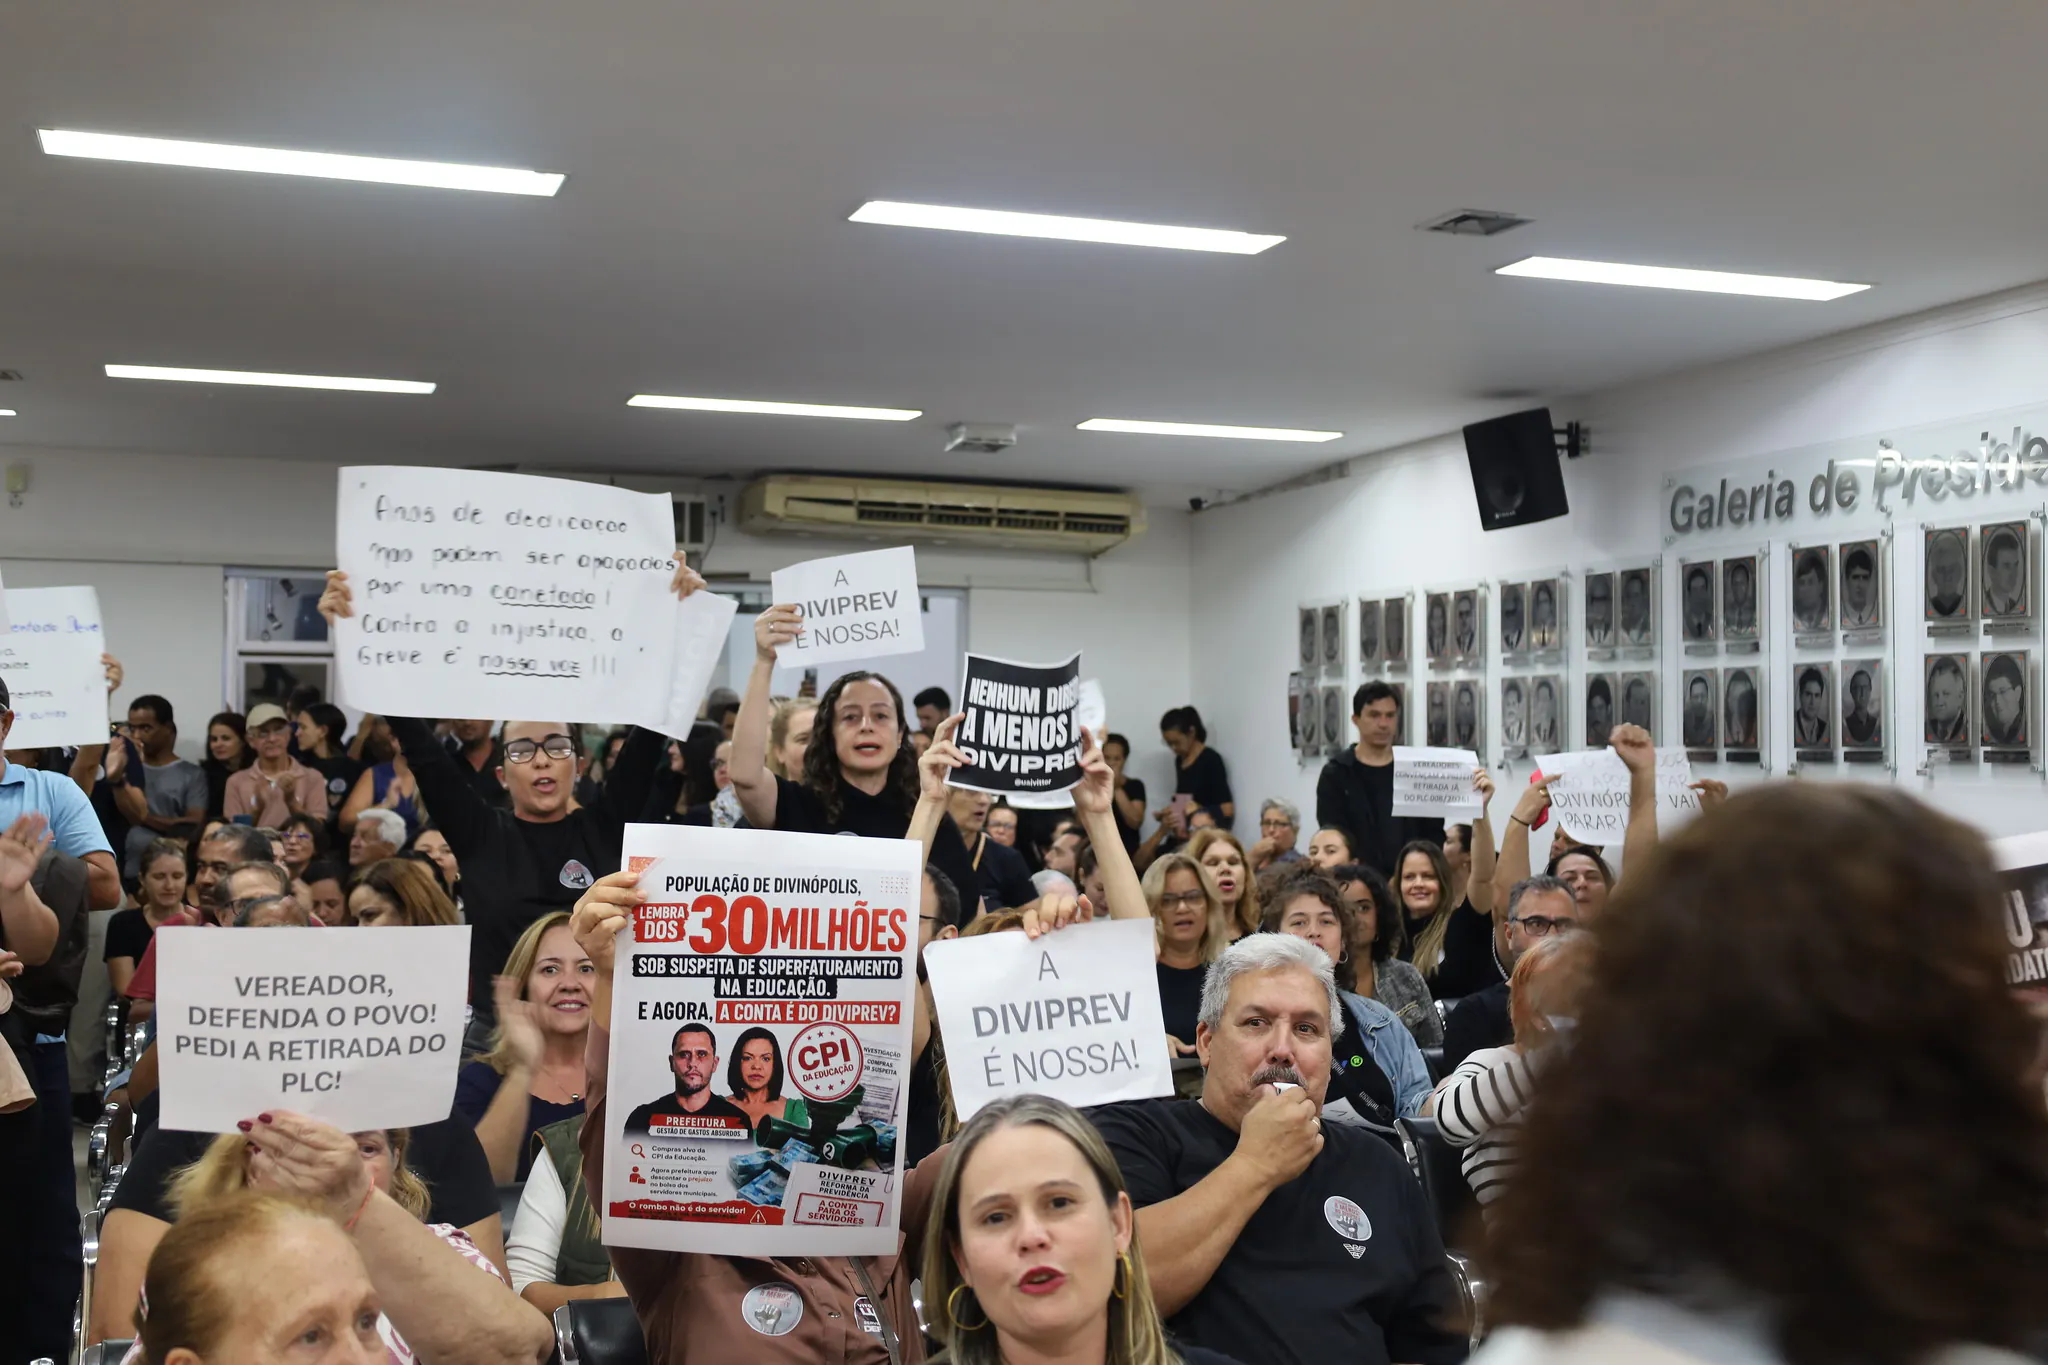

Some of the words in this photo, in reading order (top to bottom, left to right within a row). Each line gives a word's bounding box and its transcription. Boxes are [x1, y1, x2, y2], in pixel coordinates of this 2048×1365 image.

[1670, 470, 1794, 533] Galeria
[1809, 459, 1858, 513] de
[453, 500, 484, 525] de
[526, 551, 565, 566] ser
[834, 569, 849, 587] A
[421, 582, 473, 598] uma
[794, 589, 899, 620] DIVIPREV
[361, 613, 437, 634] Contra
[814, 618, 901, 647] NOSSA!
[357, 645, 422, 666] Greve
[968, 677, 1041, 716] NENHUM
[961, 706, 977, 743] A
[982, 710, 1068, 752] MENOS
[1413, 782, 1449, 791] RETIRADA
[1417, 794, 1428, 802] PLC
[1669, 794, 1696, 809] VAI
[665, 873, 749, 896] POPULAÇÃO
[753, 877, 770, 893] DE
[774, 875, 861, 896] DIVINÓPOLIS,
[640, 906, 685, 919] LEMBRA
[644, 920, 678, 939] DOS
[689, 894, 768, 954] 30
[771, 900, 907, 952] MILHÕES
[638, 957, 666, 974] SOB
[670, 958, 735, 975] SUSPEITA
[738, 958, 755, 975] DE
[759, 959, 899, 976] SUPERFATURAMENTO
[1038, 950, 1060, 981] A
[235, 974, 393, 998] VEREADOR,
[720, 978, 741, 996] NA
[746, 977, 830, 999] EDUCAÇÃO.
[188, 1005, 319, 1029] DEFENDA
[326, 1006, 346, 1027] O
[353, 1003, 437, 1026] POVO!
[638, 1001, 647, 1020] E
[652, 1001, 713, 1023] AGORA,
[720, 1003, 730, 1021] A
[734, 1003, 782, 1021] CONTA
[786, 1001, 794, 1021] É
[798, 1004, 818, 1021] DO
[823, 1004, 897, 1022] DIVIPREV?
[972, 991, 1131, 1038] DIVIPREV
[176, 1035, 236, 1059] PEDI
[243, 1040, 261, 1061] A
[268, 1036, 402, 1061] RETIRADA
[408, 1033, 446, 1055] DO
[798, 1038, 850, 1071] CPI
[864, 1047, 901, 1058] NVESTIGAÇÃO
[867, 1059, 893, 1068] COMPRAS
[871, 1066, 897, 1076] SUSPEITA
[983, 1046, 1005, 1088] É
[1012, 1038, 1141, 1084] NOSSA!
[281, 1071, 342, 1092] PLC!
[803, 1074, 814, 1082] DA
[815, 1064, 854, 1079] EDUCAÇÃO
[657, 1127, 678, 1135] GESTÃO
[666, 1117, 726, 1127] PREFEITURA
[652, 1145, 681, 1154] Compras
[674, 1154, 707, 1162] Educação.
[825, 1143, 833, 1159] 2
[651, 1167, 670, 1176] Agora
[671, 1168, 702, 1177] prefeitura
[819, 1171, 876, 1186] DIVIPREV
[819, 1188, 869, 1199] PREVIDÊNCIA
[820, 1181, 857, 1191] REFORMA
[639, 1203, 668, 1211] rombo
[670, 1204, 686, 1212] não
[688, 1204, 693, 1212] é
[708, 1206, 746, 1214] servidor!
[818, 1207, 841, 1215] PARA
[828, 1201, 858, 1210] CONTA
[808, 1213, 864, 1225] SERVIDORES
